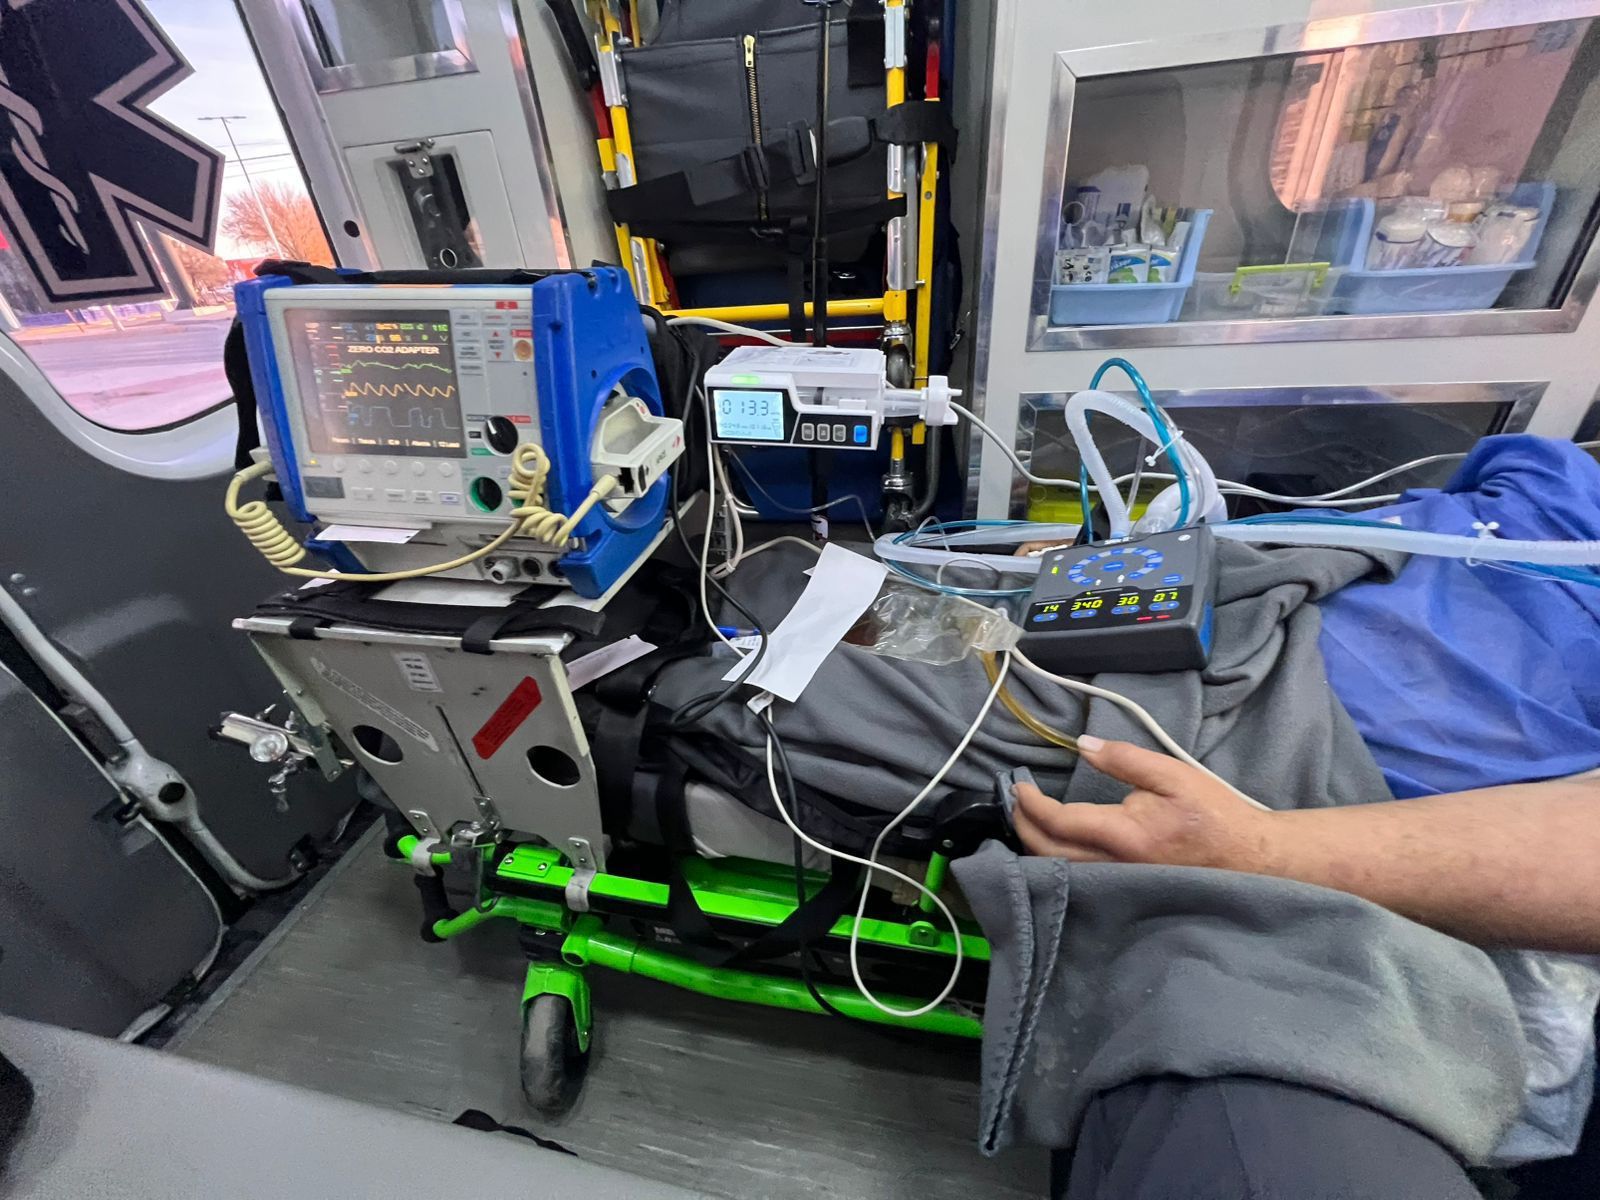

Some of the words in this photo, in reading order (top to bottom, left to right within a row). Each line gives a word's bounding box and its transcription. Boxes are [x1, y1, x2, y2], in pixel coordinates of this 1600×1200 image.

[347, 345, 373, 353] ZERO
[374, 346, 395, 354] CO2
[395, 346, 440, 355] ADAPTER
[1043, 604, 1059, 613] 14
[1071, 600, 1103, 611] 340
[1118, 596, 1140, 606] 30
[1153, 592, 1178, 602] 07
